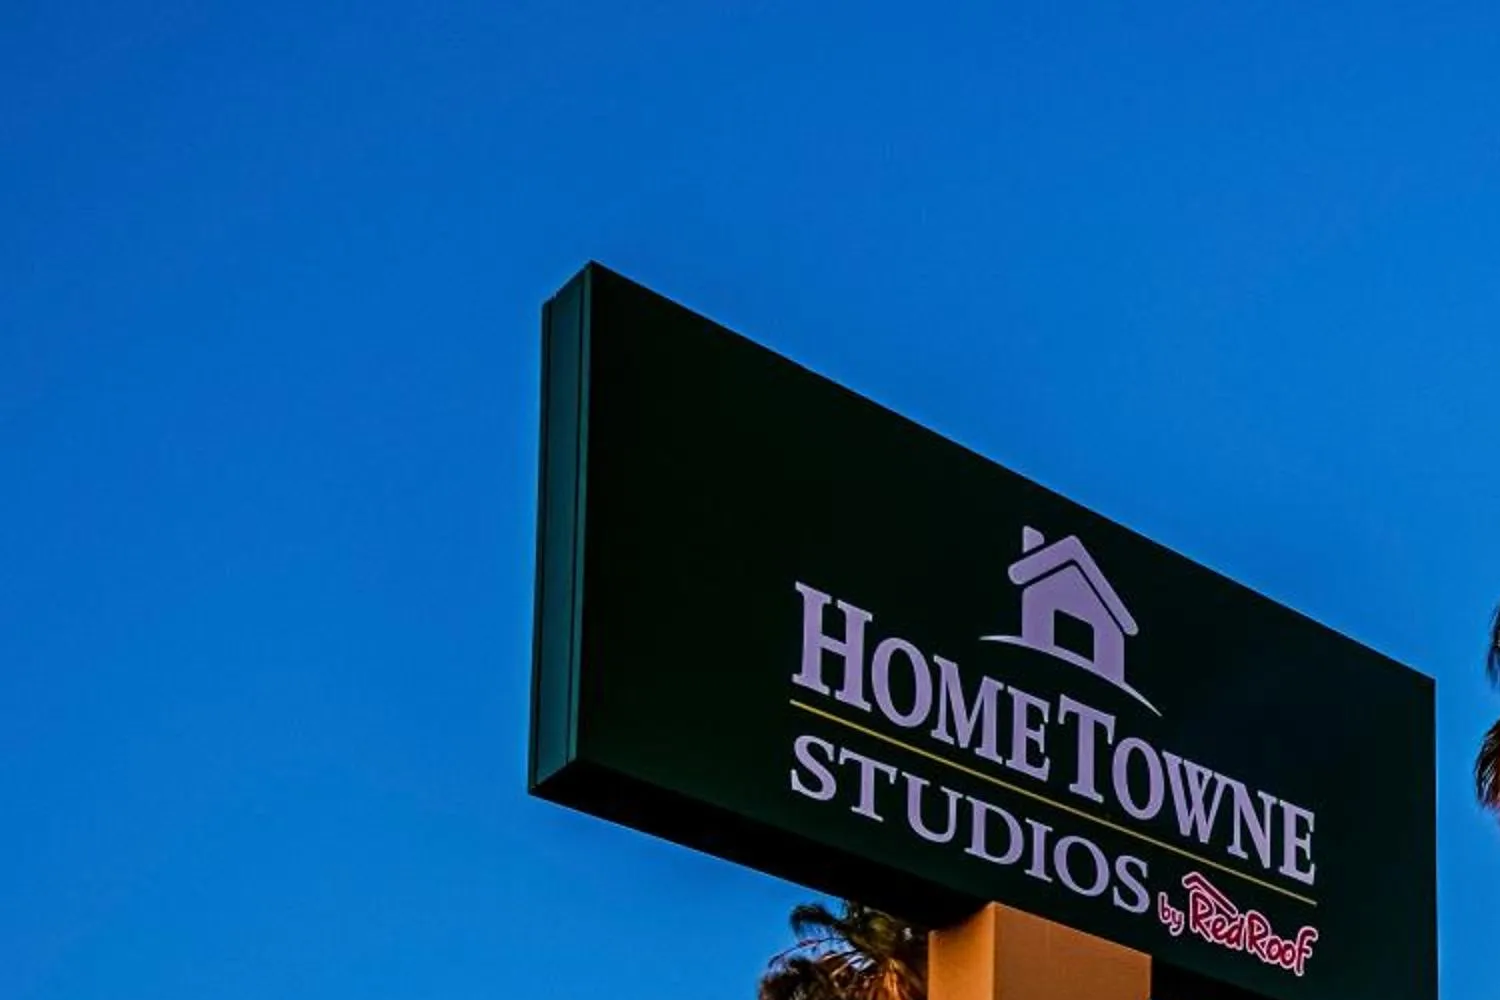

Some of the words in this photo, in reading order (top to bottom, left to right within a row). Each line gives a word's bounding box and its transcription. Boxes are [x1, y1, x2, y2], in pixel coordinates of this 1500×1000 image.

[791, 581, 1317, 886] HOMETOWNE
[791, 734, 1151, 914] STUDIOS
[1158, 891, 1185, 936] by
